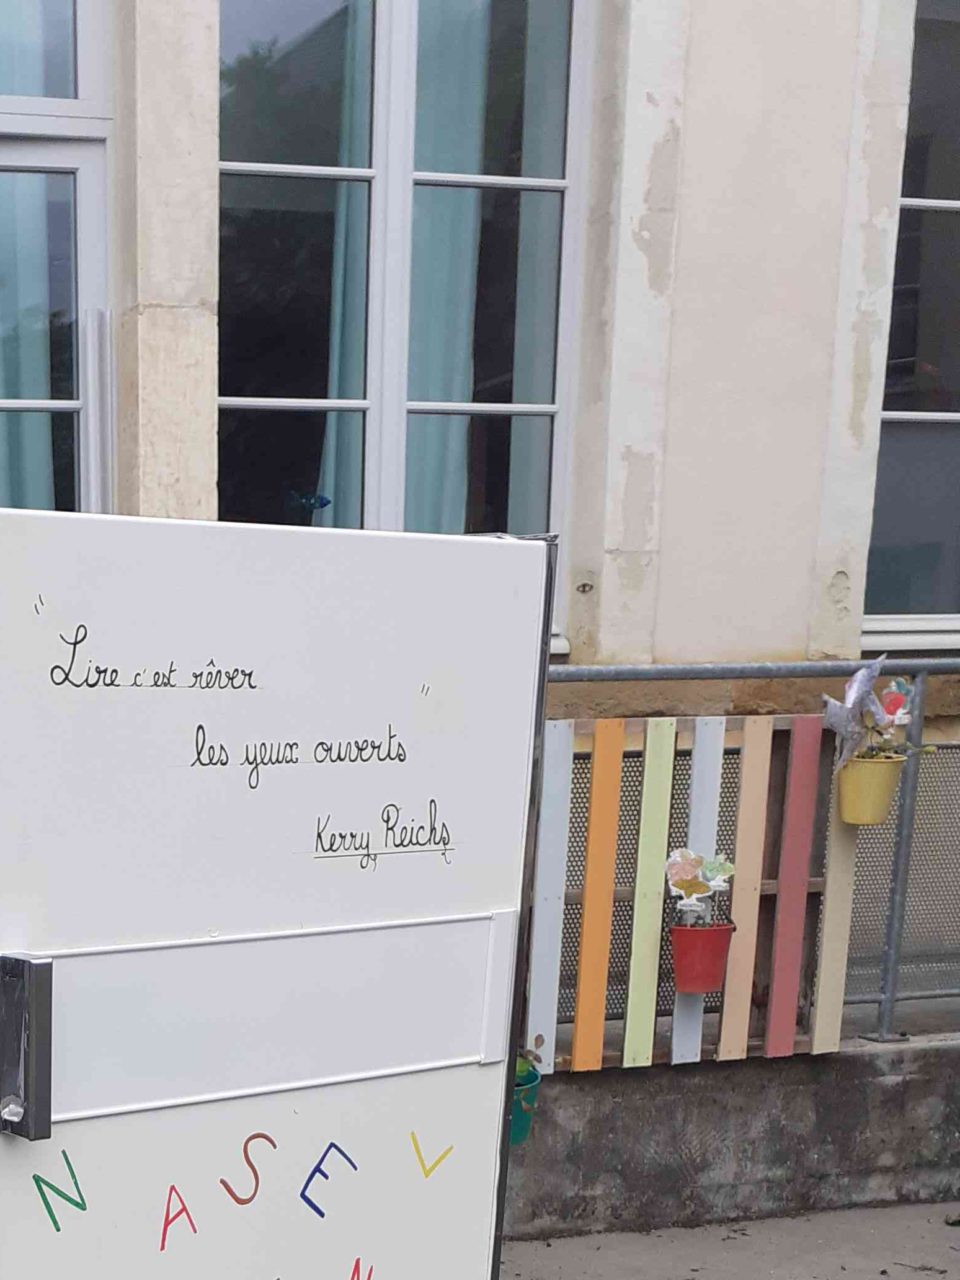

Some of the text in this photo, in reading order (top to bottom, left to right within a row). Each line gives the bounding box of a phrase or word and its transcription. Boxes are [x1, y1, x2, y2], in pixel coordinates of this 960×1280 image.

[50, 624, 120, 688] Lire
[188, 658, 258, 689] rêver
[190, 723, 408, 790] les yeux ouverts
[313, 813, 378, 870] Kerry
[32, 1149, 87, 1232] N
[219, 1132, 277, 1205] S
[299, 1141, 358, 1219] E
[159, 1184, 197, 1252] A
